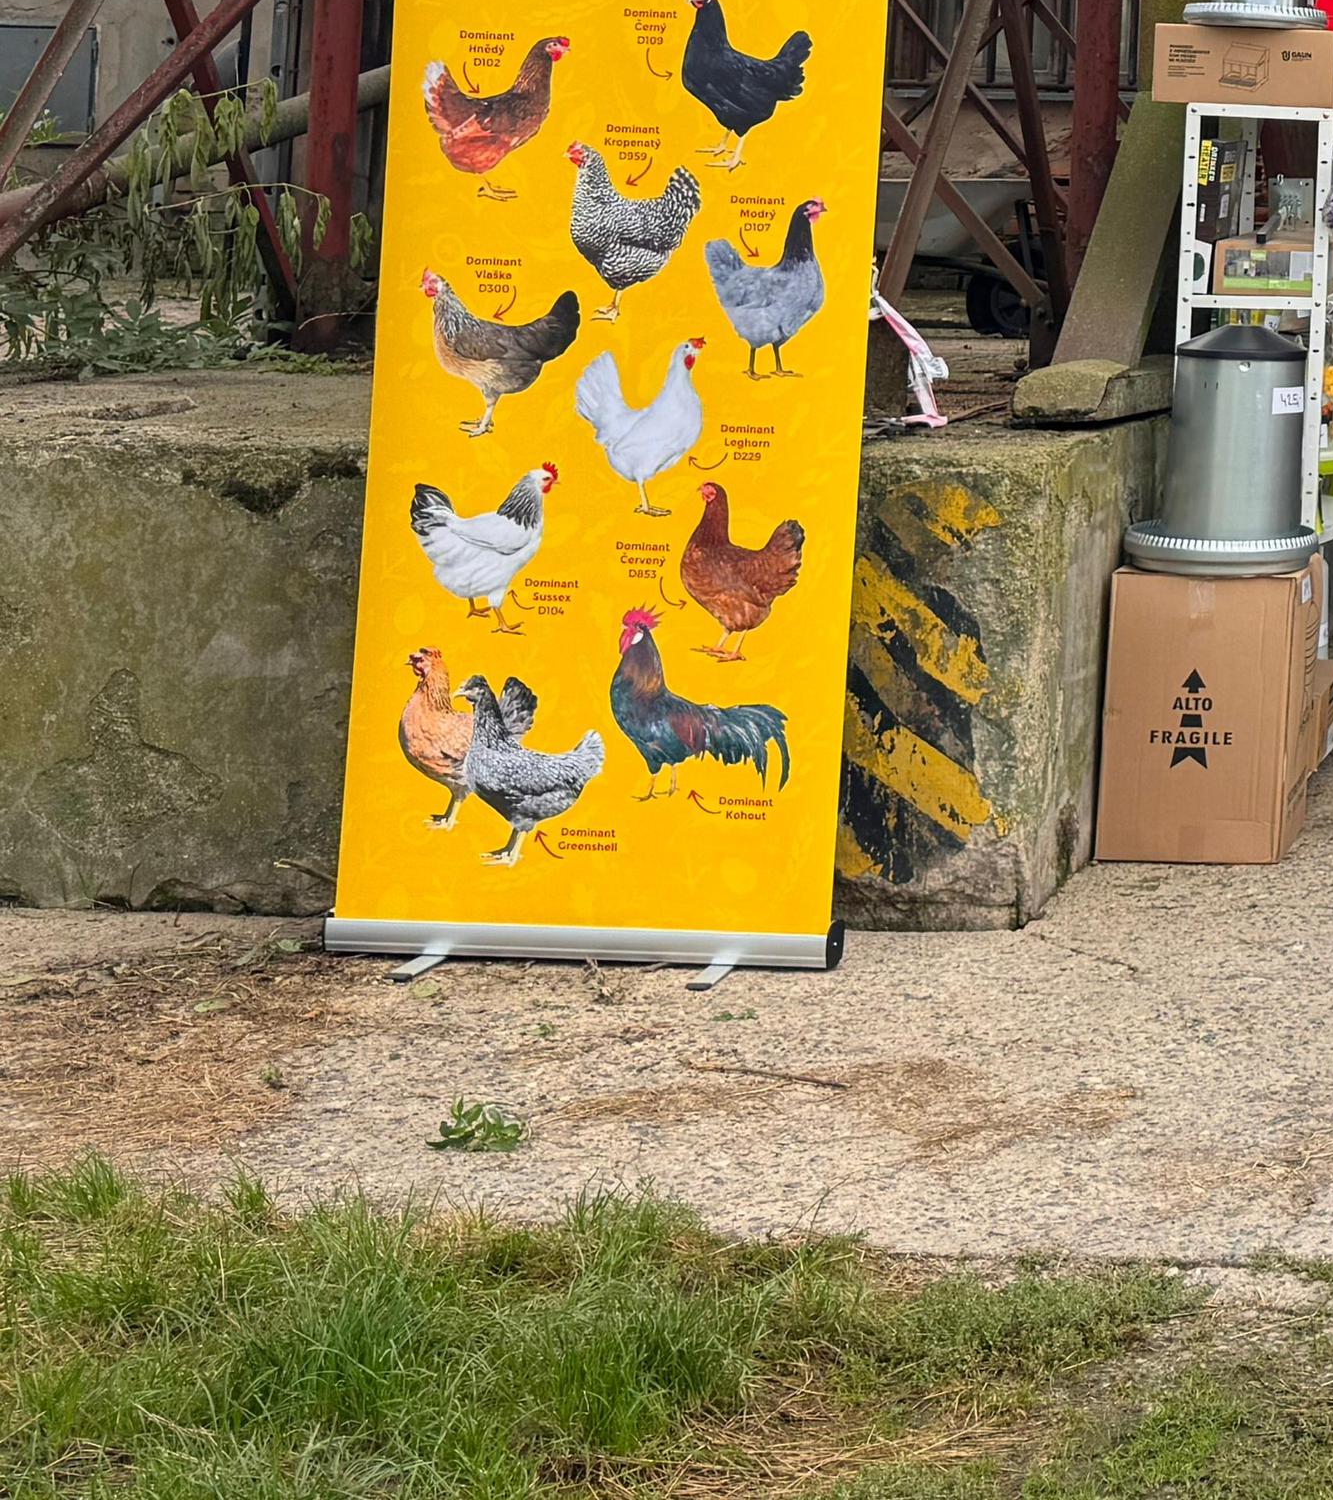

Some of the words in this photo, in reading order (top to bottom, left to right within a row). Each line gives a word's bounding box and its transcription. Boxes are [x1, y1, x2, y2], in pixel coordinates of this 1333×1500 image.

[624, 8, 677, 19] Dominant
[634, 19, 667, 33] Černý
[459, 31, 515, 41] Dominant
[637, 36, 664, 46] D109
[469, 44, 505, 56] Hnědý
[473, 58, 501, 67] D102
[606, 124, 660, 134] Dominant
[604, 137, 661, 150] Kropenatý
[730, 195, 786, 205] Dominant
[739, 207, 777, 221] Modrý
[744, 222, 771, 232] D107
[466, 256, 523, 267] Dominant
[475, 269, 512, 280] Vlaška
[478, 283, 510, 294] D300
[720, 424, 776, 435] Dominant
[724, 437, 771, 450] Leghorn
[733, 452, 762, 462] D229
[615, 541, 671, 552] Dominant
[620, 553, 667, 567] Červený
[628, 568, 658, 579] D853
[524, 578, 580, 589] Dominant
[532, 591, 572, 603] Sussex
[537, 605, 565, 616] D104
[1172, 696, 1213, 712] ALTO
[1149, 729, 1233, 747] FRAGILE
[718, 796, 774, 807] Dominant
[725, 809, 767, 821] Kohout
[560, 827, 617, 838] Dominant
[557, 840, 618, 852] Greenshell
